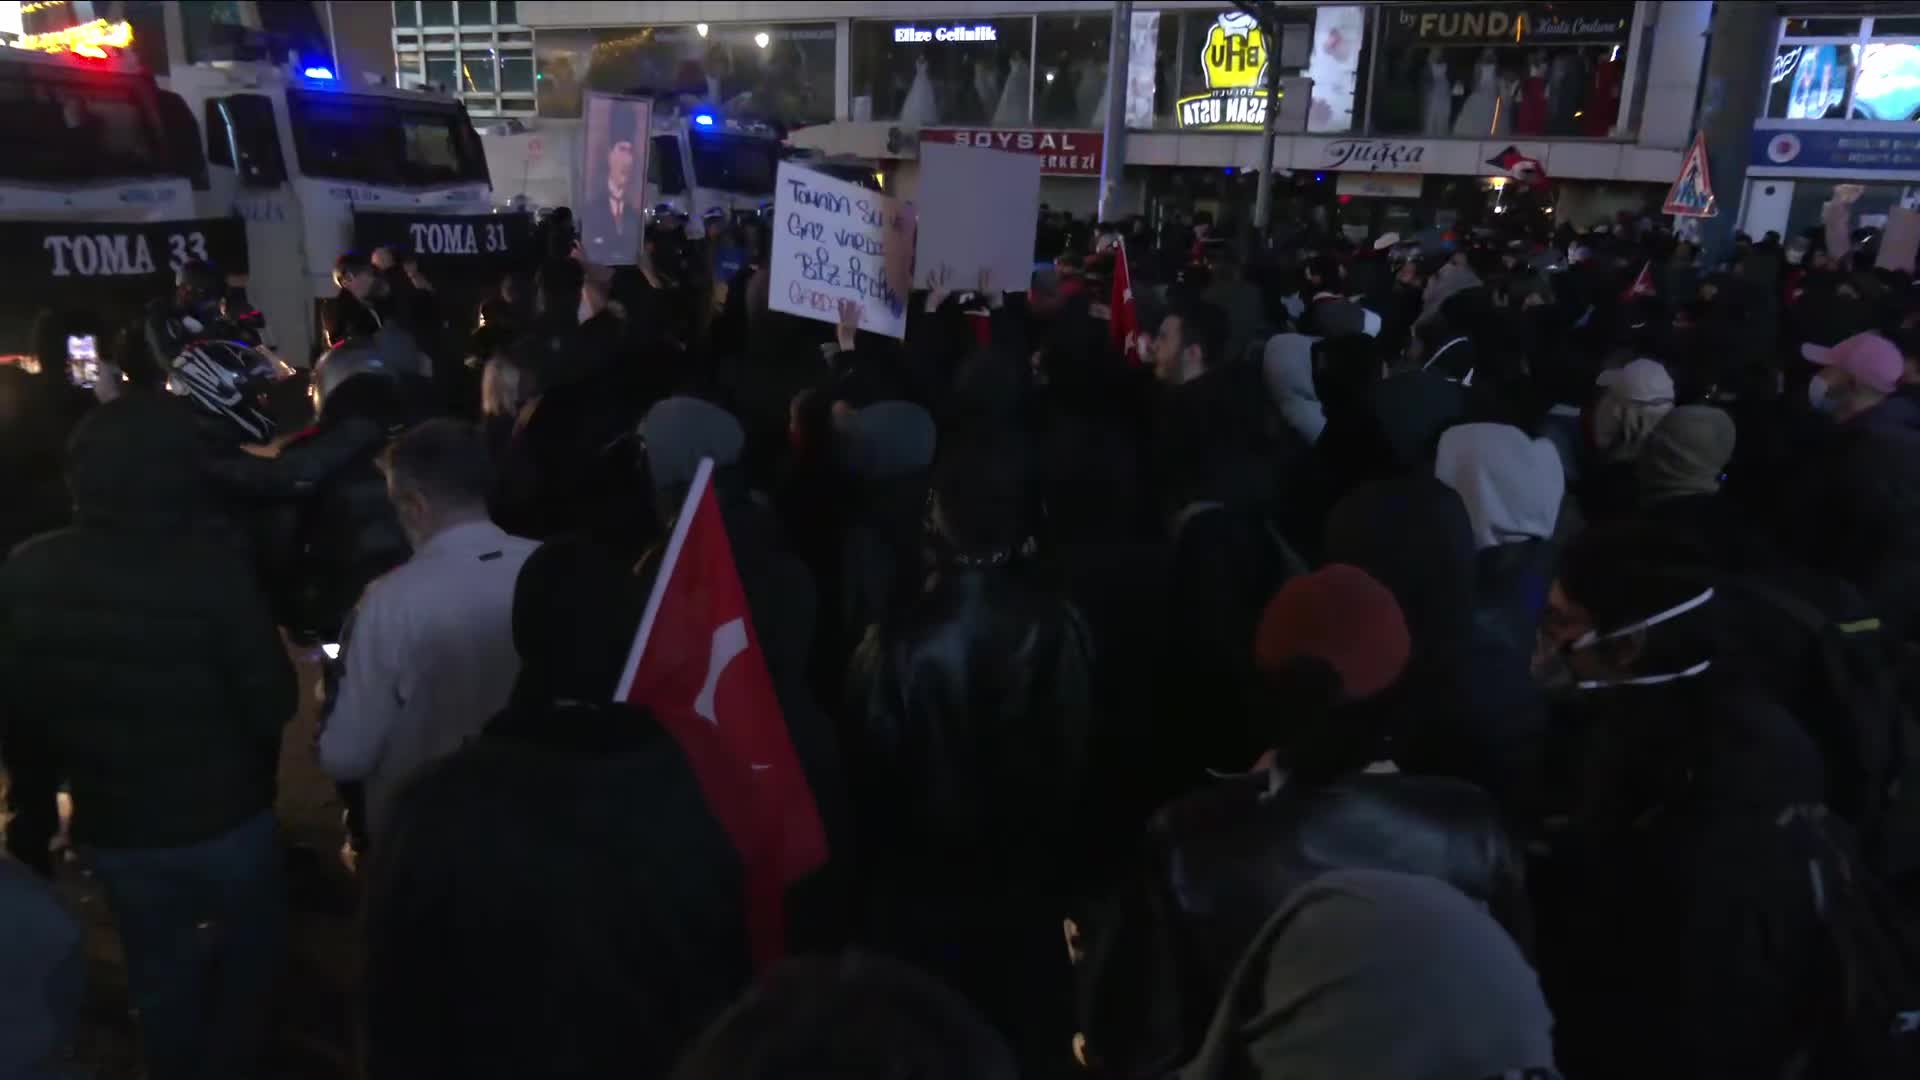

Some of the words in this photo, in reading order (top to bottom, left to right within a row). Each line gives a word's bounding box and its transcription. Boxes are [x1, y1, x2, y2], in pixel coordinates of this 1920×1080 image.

[935, 25, 997, 41] Gelinlik
[1399, 9, 1415, 27] by
[1419, 11, 1532, 38] FUNDA
[953, 131, 1076, 150] SOYSAL
[1039, 153, 1096, 169] ERKEZİ
[409, 223, 479, 255] TOMA
[485, 223, 508, 252] 31
[42, 233, 157, 277] TOMA
[168, 231, 209, 273] 33
